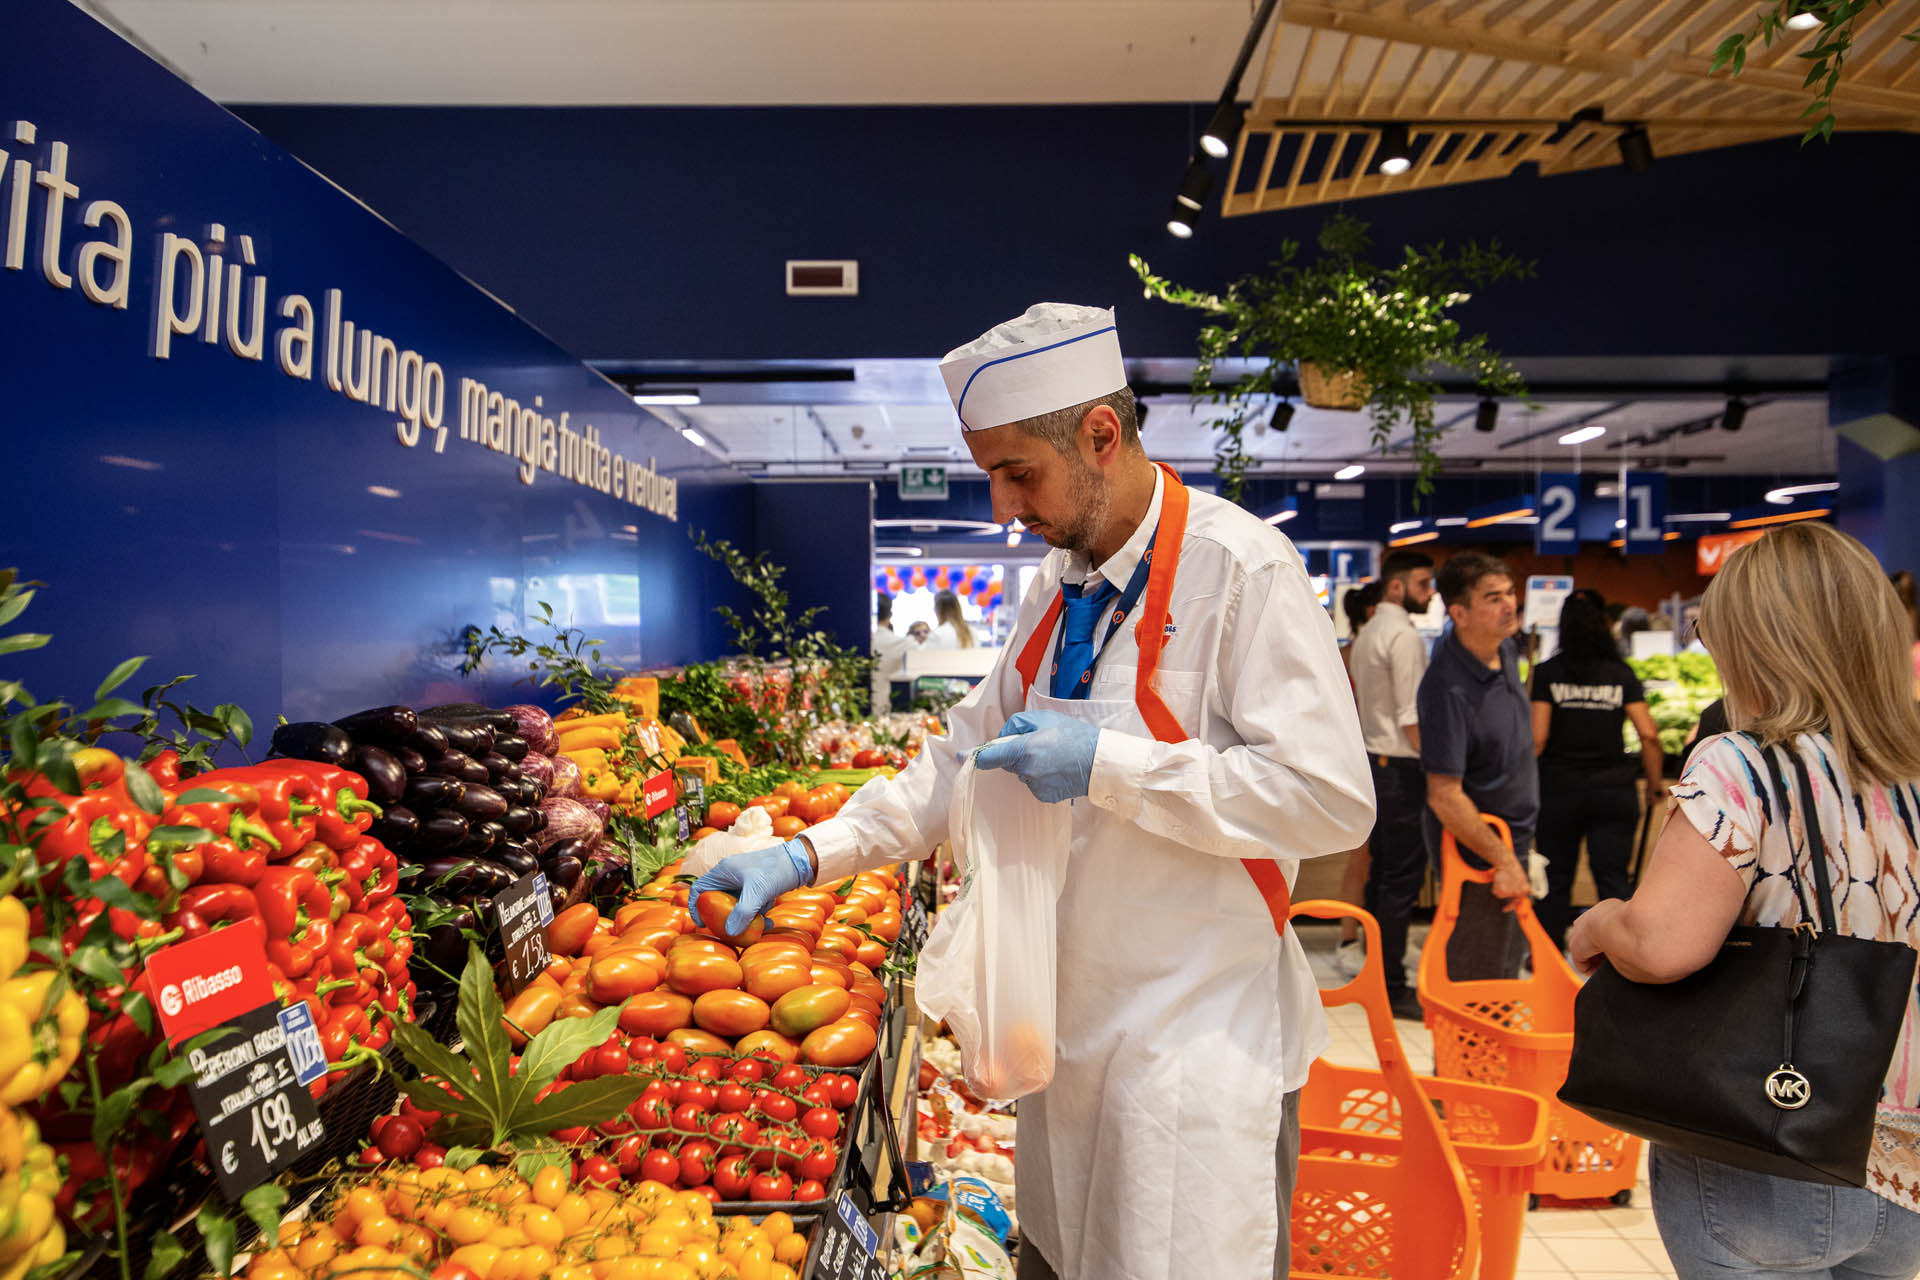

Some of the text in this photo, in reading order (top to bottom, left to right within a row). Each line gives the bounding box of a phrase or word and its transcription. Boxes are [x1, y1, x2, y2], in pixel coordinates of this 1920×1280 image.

[156, 223, 266, 359] più
[280, 294, 314, 380] a
[327, 288, 448, 453] lungo,
[460, 377, 555, 485] mangia
[558, 411, 611, 494] frutta
[613, 454, 624, 499] e
[1542, 485, 1576, 541] 2
[1629, 485, 1660, 541] 1
[182, 965, 243, 1005] Ribasso
[1770, 1078, 1804, 1099] MK
[221, 1140, 240, 1175] €
